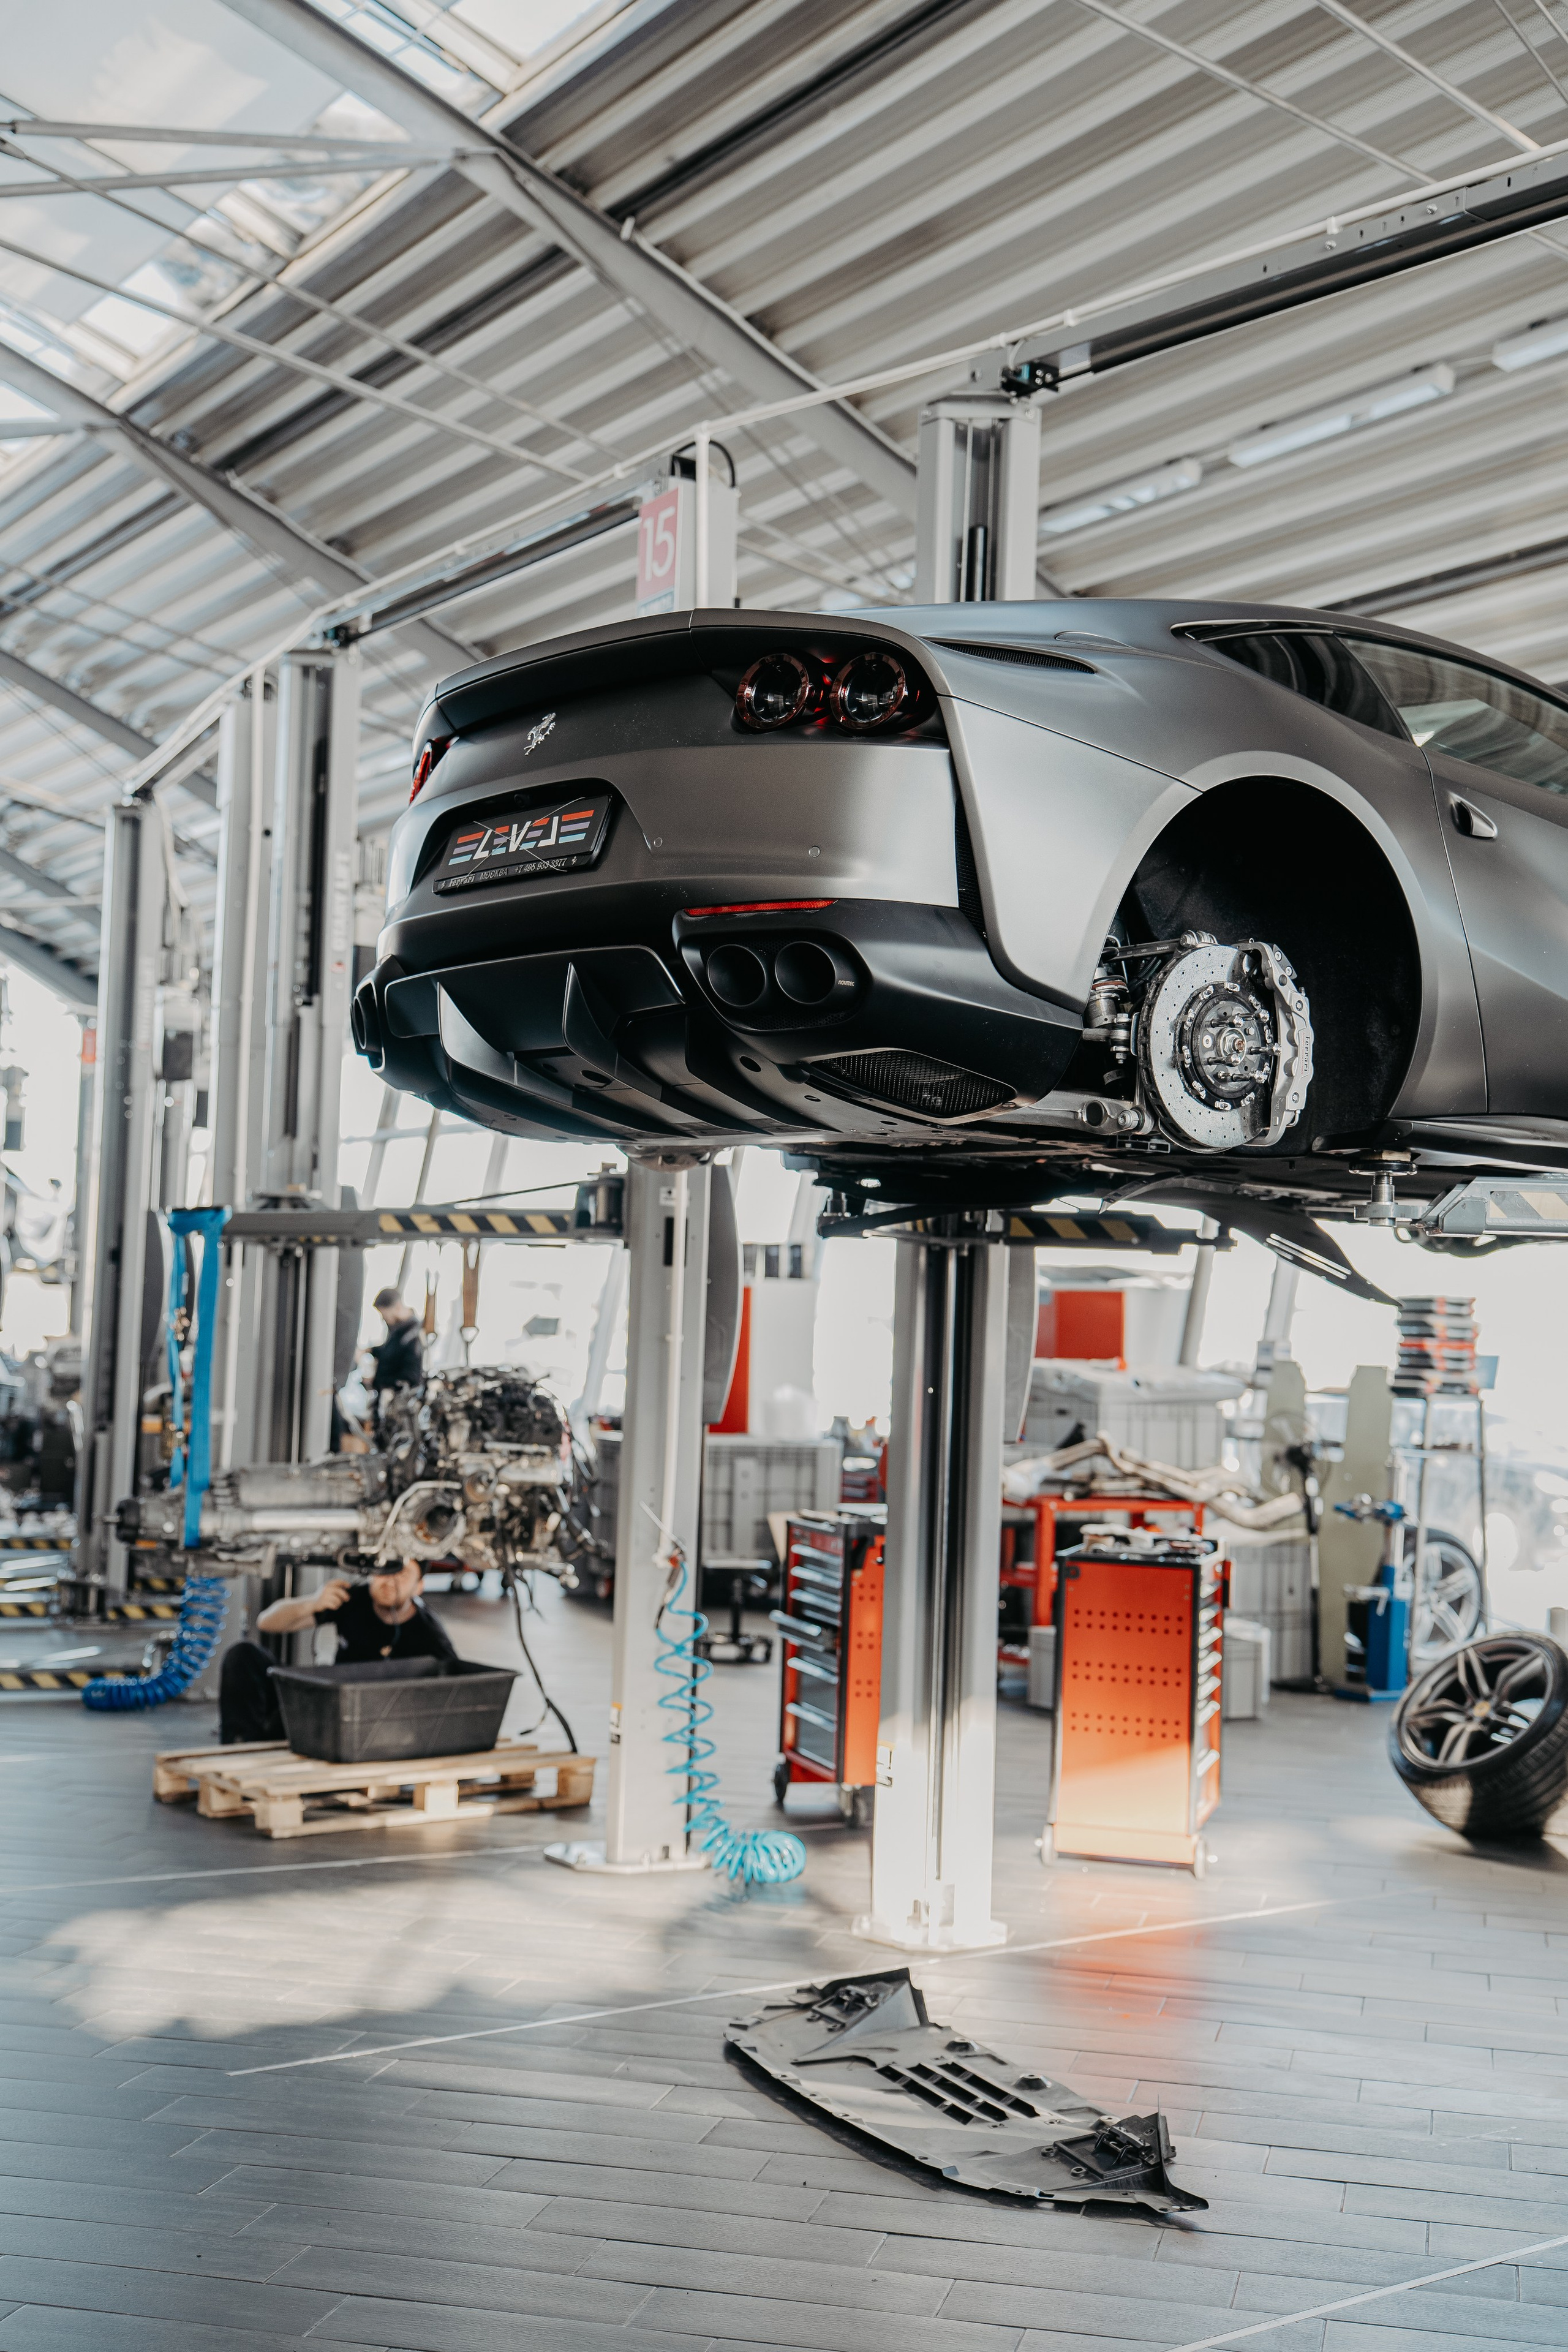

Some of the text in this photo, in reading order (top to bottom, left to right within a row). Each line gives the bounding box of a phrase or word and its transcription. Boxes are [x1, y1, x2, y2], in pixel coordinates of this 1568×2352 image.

[643, 507, 675, 582] 15
[524, 863, 536, 872] 495
[537, 861, 550, 870] 933
[550, 858, 567, 868] 3377
